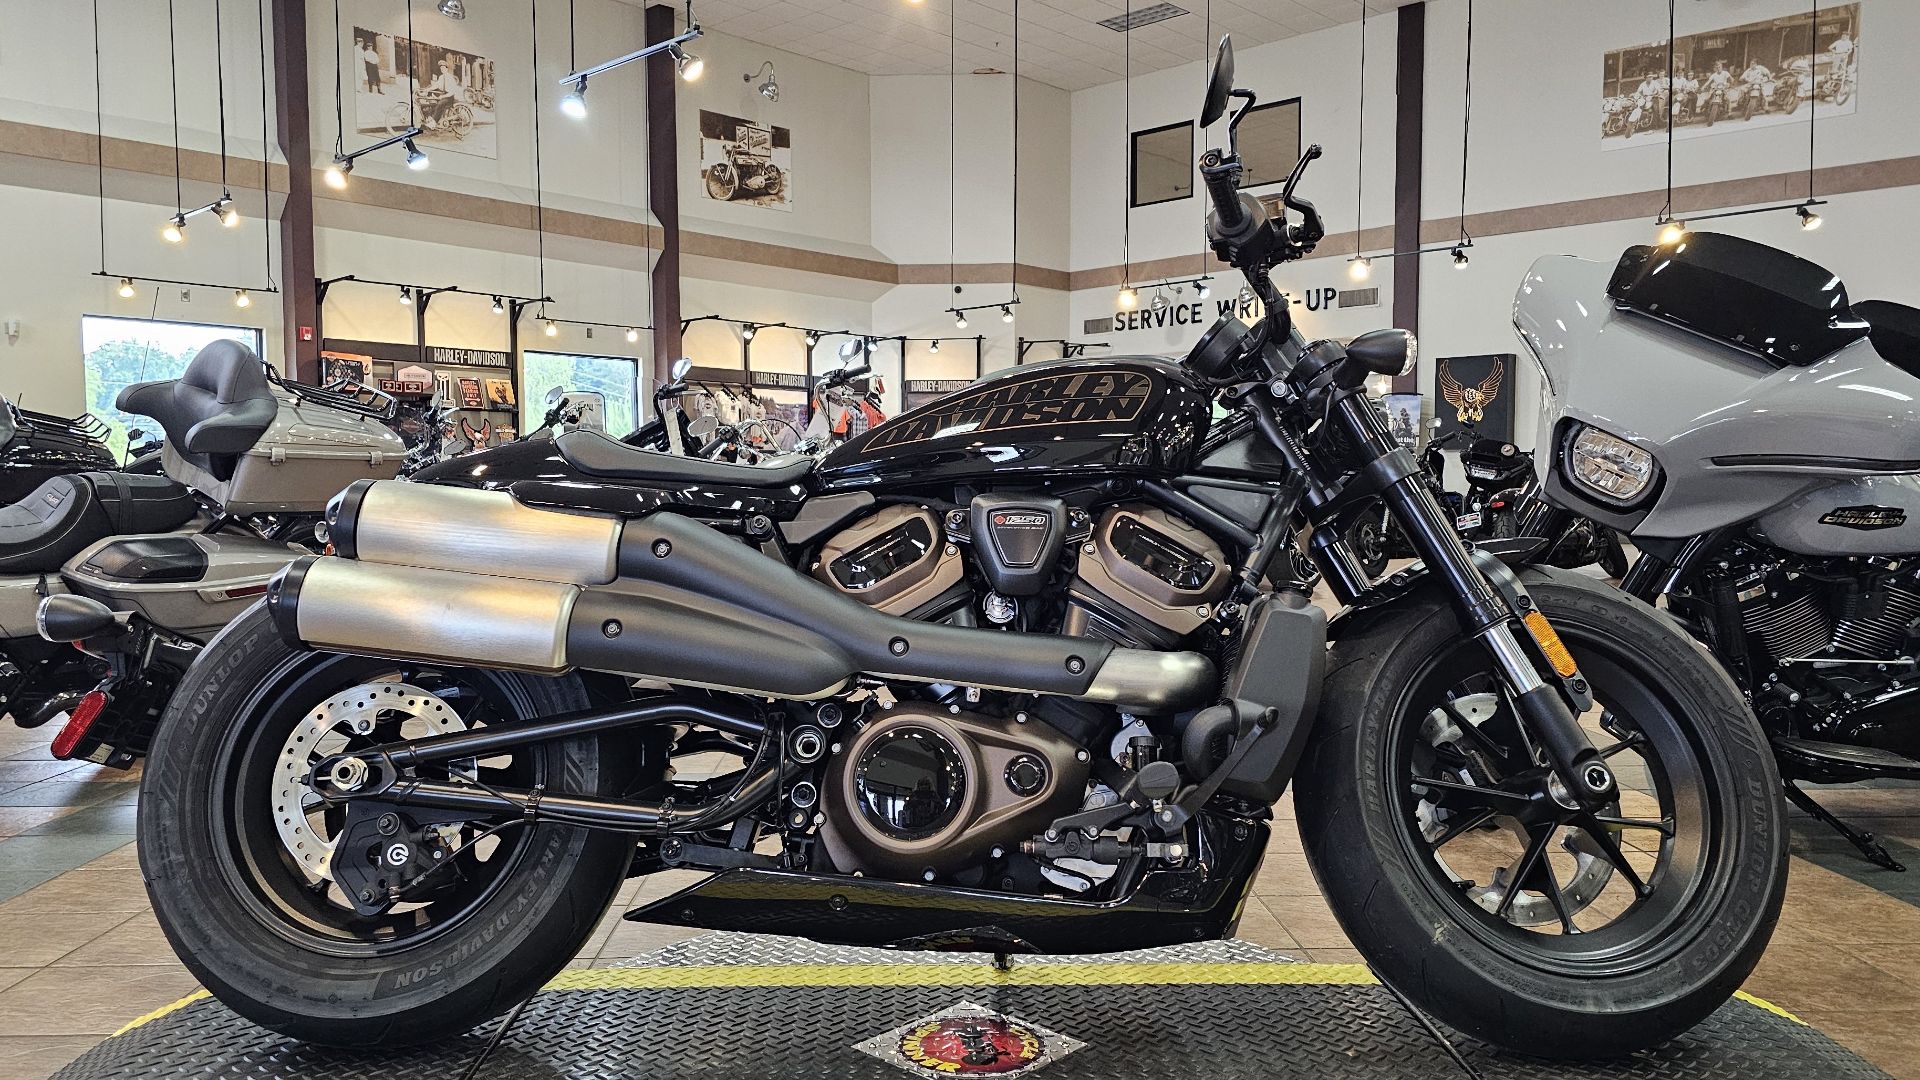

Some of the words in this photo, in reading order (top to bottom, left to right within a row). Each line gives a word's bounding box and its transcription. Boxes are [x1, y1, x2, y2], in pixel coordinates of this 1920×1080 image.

[1114, 303, 1203, 331] SERVICE
[1217, 287, 1337, 320] WRI-UP
[433, 347, 507, 366] HARLEY-DAVIDSON
[755, 372, 806, 387] HARLEY-DAVIDSON
[955, 372, 1150, 412] HARLEY
[878, 396, 1142, 445] DAVIDSON
[1005, 515, 1046, 525] 1250
[183, 632, 260, 735] DUNLOP
[1749, 778, 1768, 894] DUNLOP
[902, 1023, 961, 1073] SPINNER
